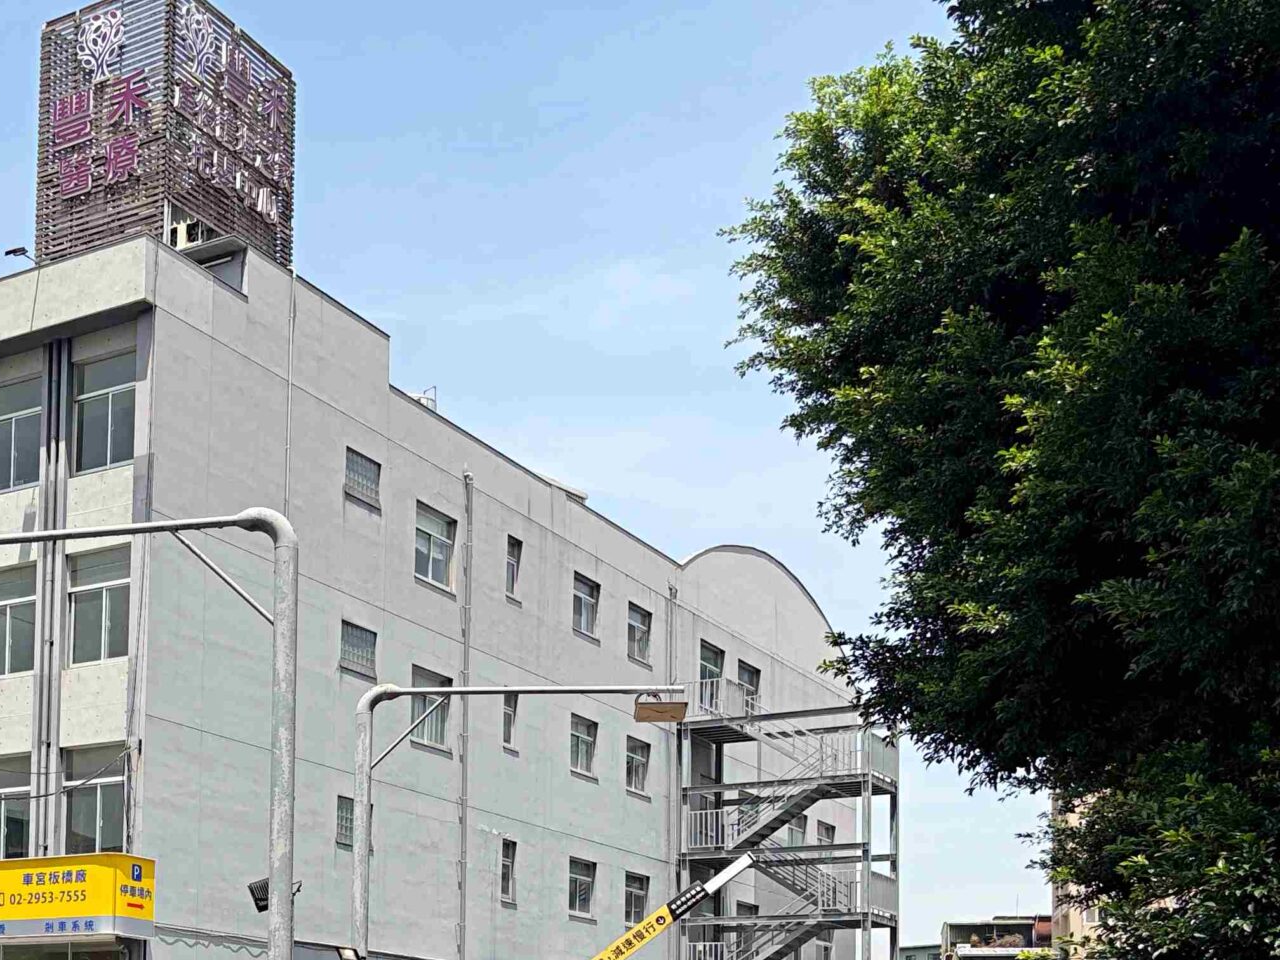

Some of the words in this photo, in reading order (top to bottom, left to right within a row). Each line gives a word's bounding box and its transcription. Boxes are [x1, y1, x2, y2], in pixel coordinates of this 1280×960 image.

[52, 68, 150, 150] 豐禾
[58, 132, 141, 199] 醫療
[9, 890, 87, 906] 02-2953-7555
